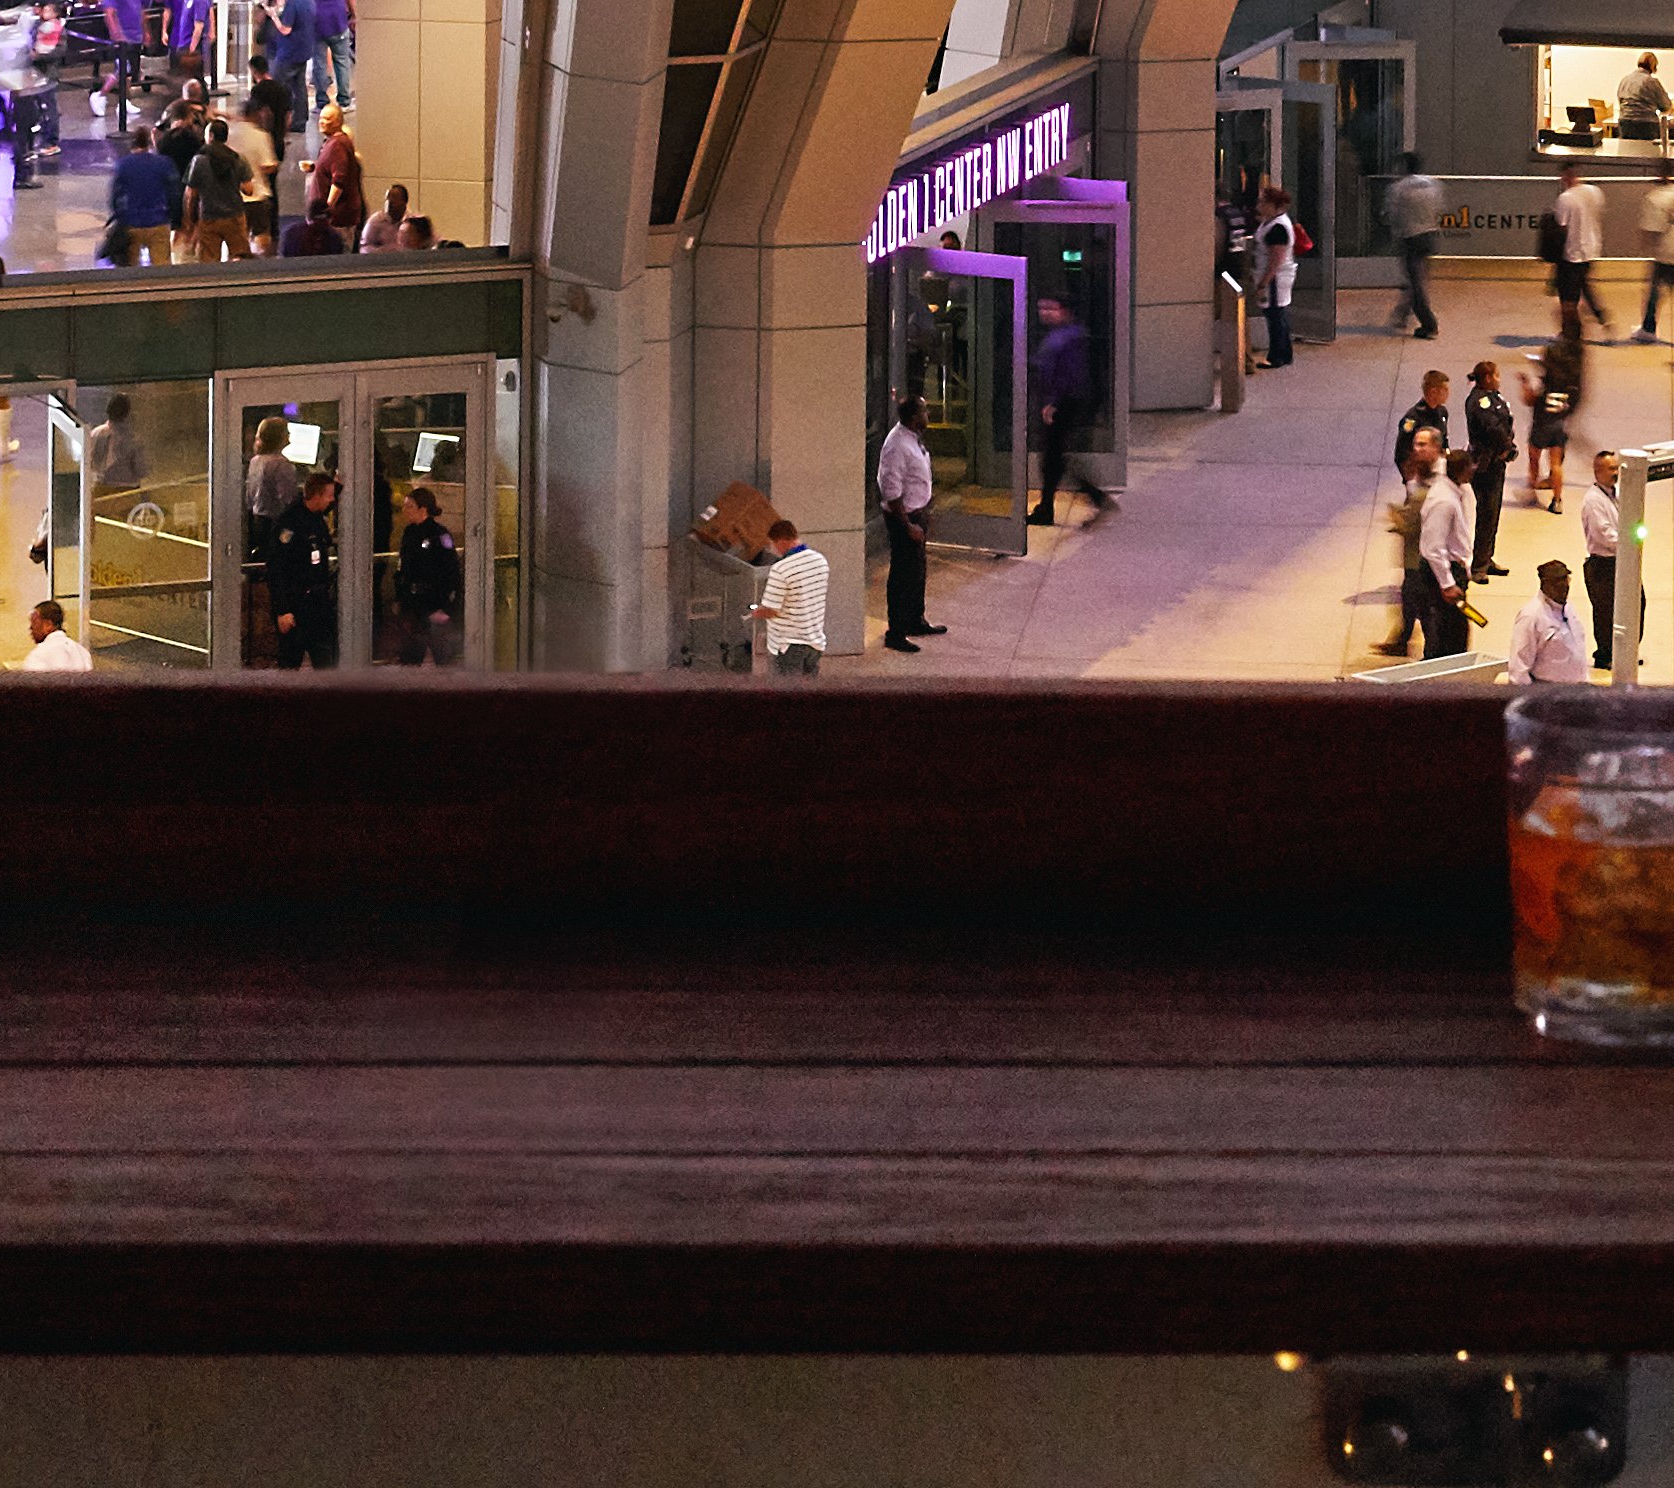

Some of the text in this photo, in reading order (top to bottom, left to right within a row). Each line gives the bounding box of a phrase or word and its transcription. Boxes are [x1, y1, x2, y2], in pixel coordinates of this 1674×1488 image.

[935, 142, 992, 228] CENTER
[996, 127, 1021, 196] NW
[1025, 102, 1070, 181] ENTRY
[1473, 214, 1543, 230] CENTE
